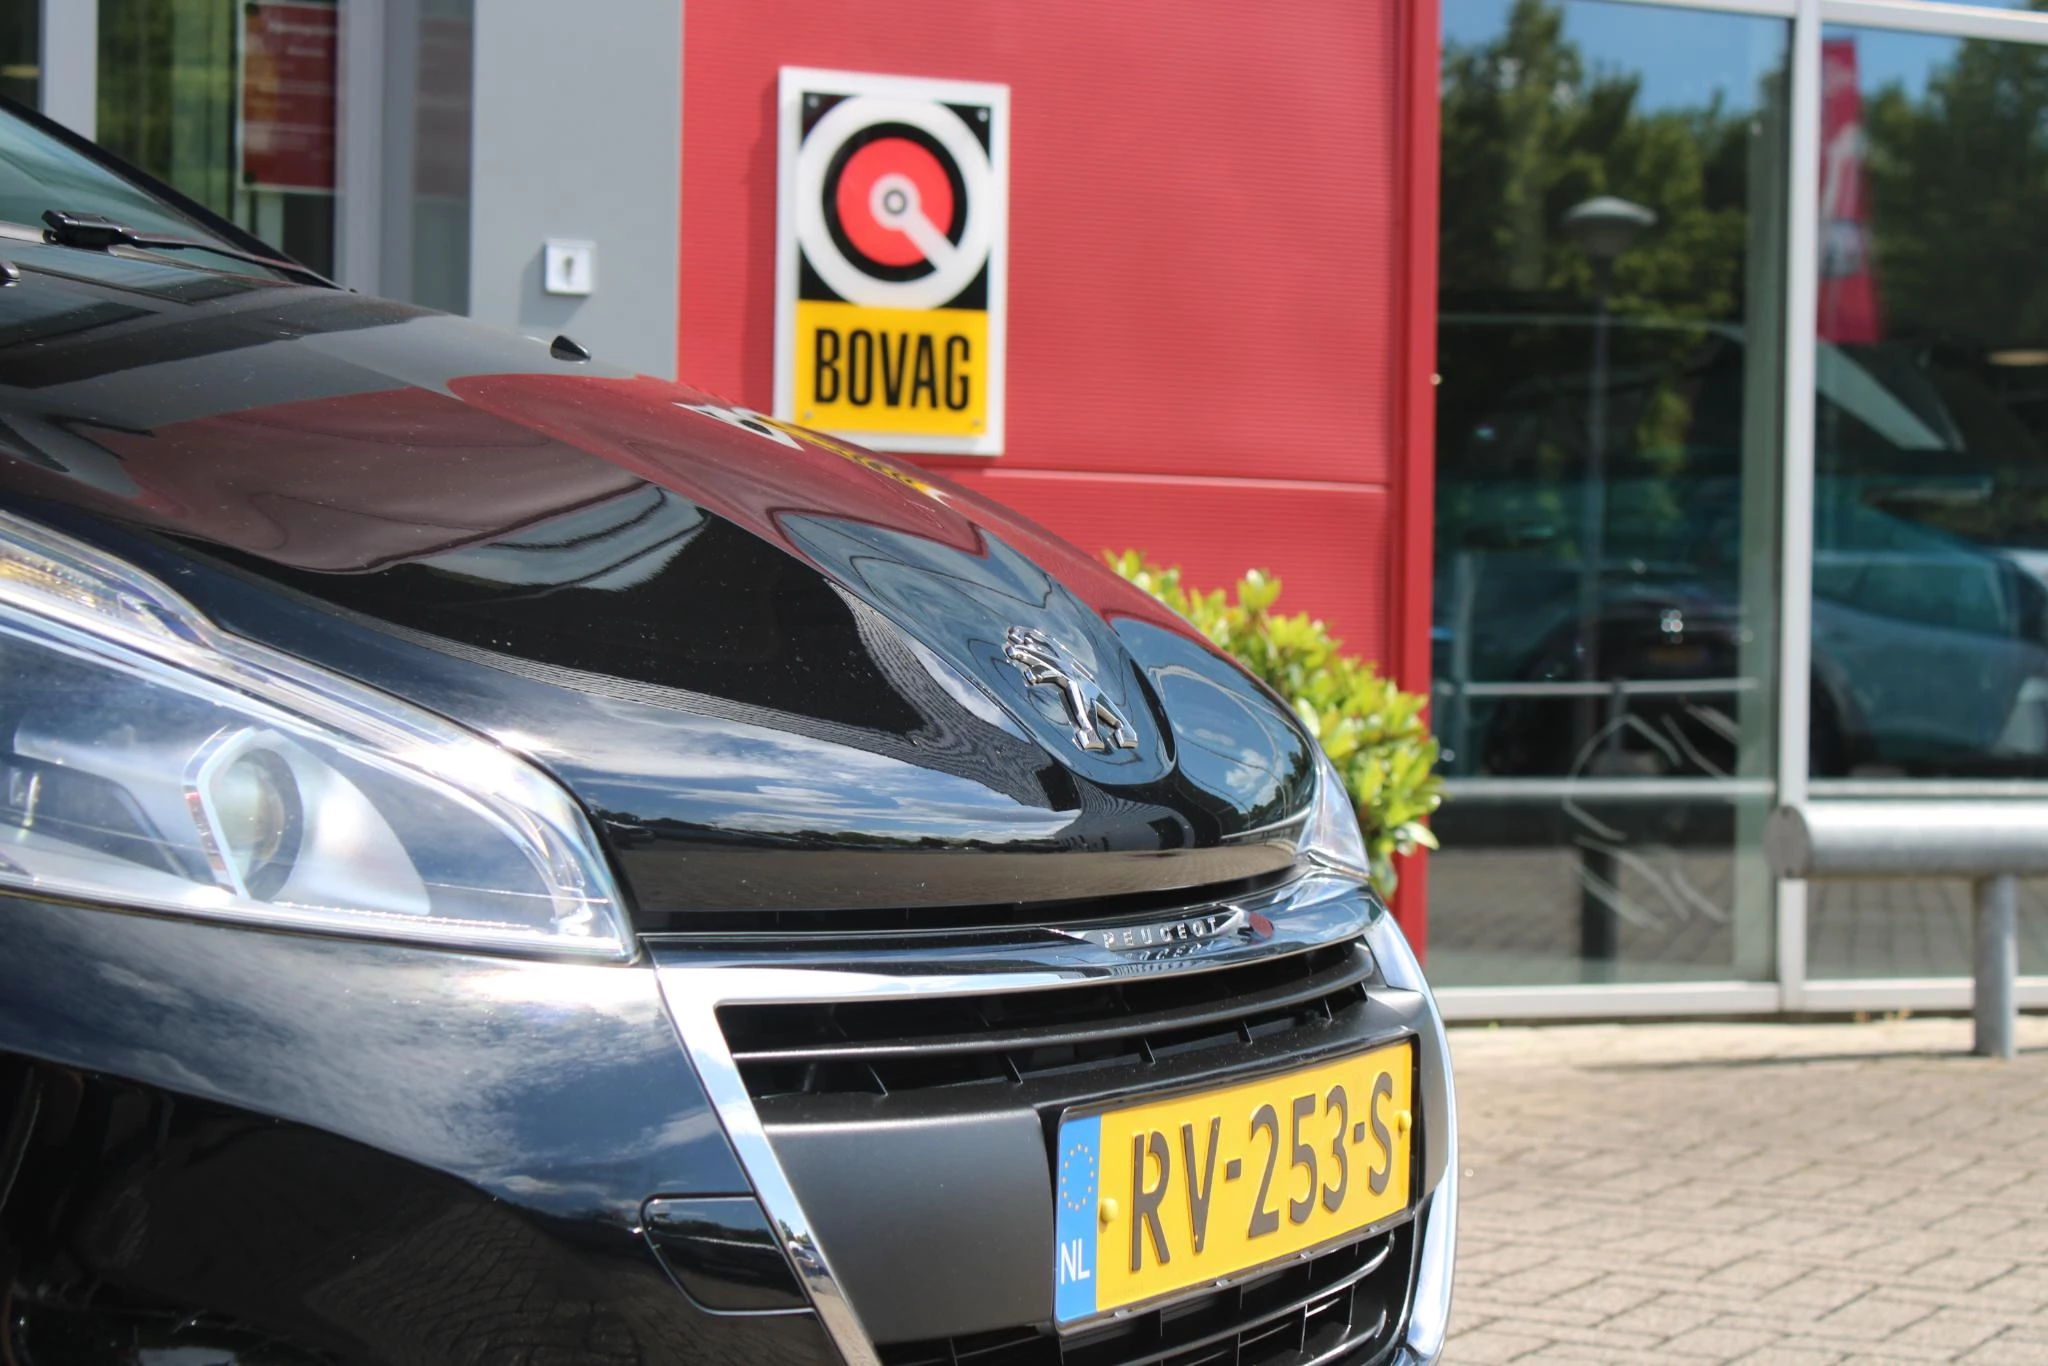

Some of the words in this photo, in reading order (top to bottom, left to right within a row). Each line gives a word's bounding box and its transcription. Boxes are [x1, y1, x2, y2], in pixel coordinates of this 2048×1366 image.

[814, 327, 970, 412] BOVAG
[1102, 915, 1217, 949] PEUGEOT
[1129, 1070, 1394, 1273] RV-253-S
[1059, 1237, 1091, 1286] NL
